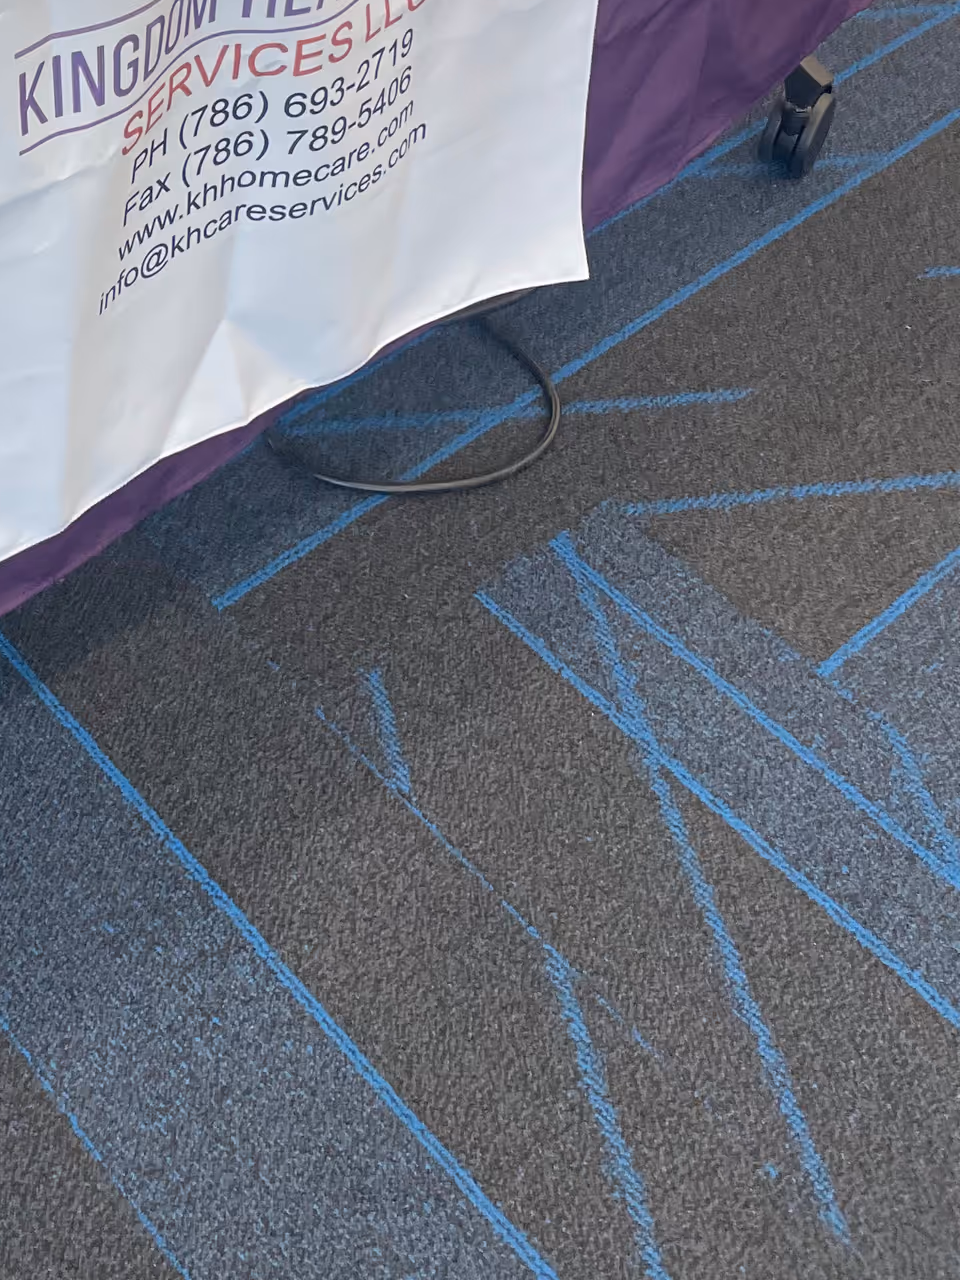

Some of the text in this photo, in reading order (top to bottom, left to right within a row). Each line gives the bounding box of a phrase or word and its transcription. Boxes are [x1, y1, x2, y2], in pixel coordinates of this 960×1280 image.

[121, 20, 355, 156] SERVICES
[122, 65, 413, 228] Fax (786) 789-5406
[131, 27, 415, 185] PH (786) 693-2719
[98, 122, 427, 316] info@khcareservices.com
[117, 99, 415, 262] www.khhomecare.com
